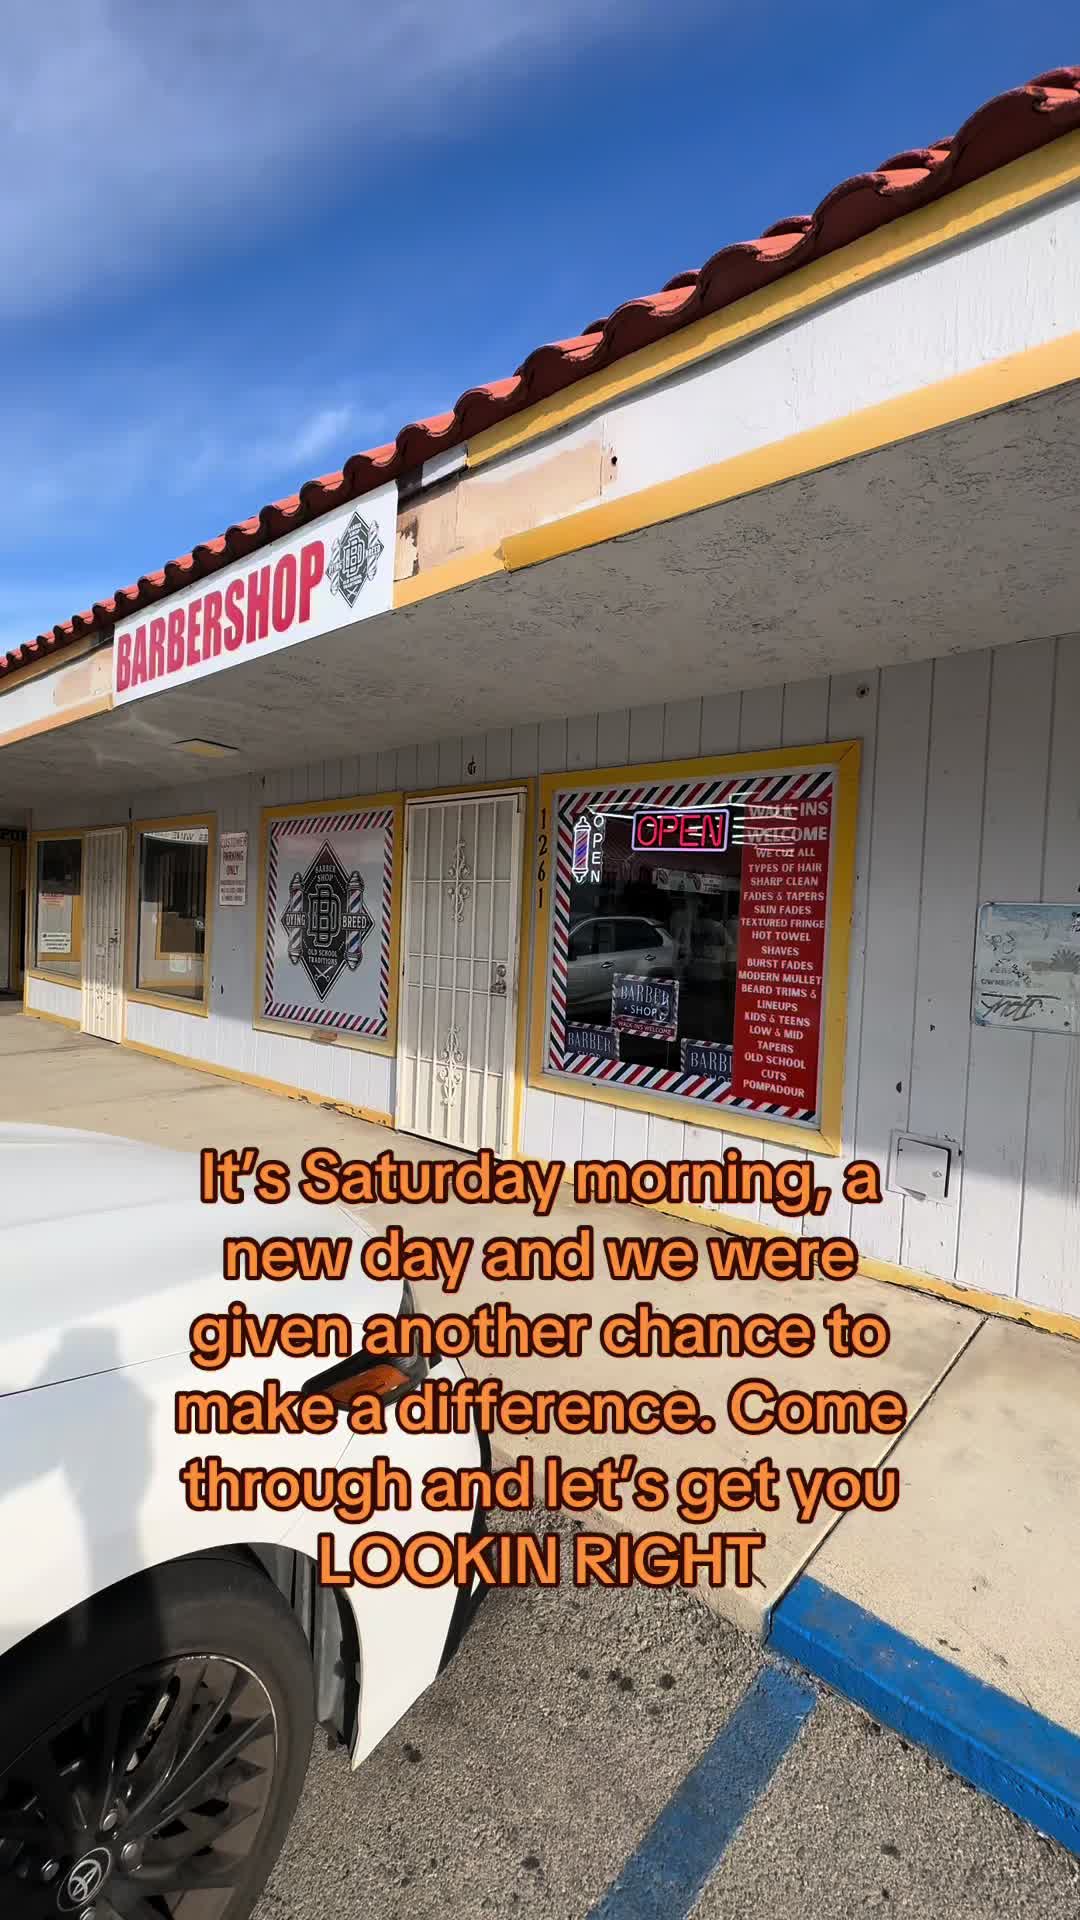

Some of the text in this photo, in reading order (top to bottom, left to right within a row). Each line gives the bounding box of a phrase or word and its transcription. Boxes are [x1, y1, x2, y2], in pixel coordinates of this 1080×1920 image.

[117, 540, 324, 692] BARBERSHOP
[801, 801, 828, 816] INS
[637, 815, 723, 847] OPEN
[748, 827, 827, 843] WELCOME
[590, 815, 604, 883] OPEN
[756, 850, 772, 858] WE
[798, 848, 815, 857] ALL
[537, 808, 548, 908] 1261
[749, 863, 822, 872] TYPES OF HAIR
[317, 873, 334, 882] SHOP
[751, 877, 818, 886] SHARP CLEAN
[743, 892, 777, 900] FADES
[787, 892, 824, 900] TAPERS
[754, 905, 811, 914] SKIN FADES
[285, 912, 306, 926] DYING
[342, 915, 367, 929] BREED
[741, 918, 825, 928] TEXTURED FRINGE
[752, 931, 811, 941] HOT TOWEL
[761, 946, 799, 955] SHAVES
[747, 958, 813, 970] BURST FADES
[738, 971, 822, 985] MODERN MULLET
[620, 984, 670, 1006] BARBER
[742, 984, 817, 999] BEARD TRIMS &
[630, 1004, 658, 1017] SHOP
[757, 1000, 798, 1012] LINEUPS
[745, 1012, 810, 1027] KIDS & TEENS
[750, 1026, 804, 1039] LOW & MID
[568, 1031, 612, 1052] BARBER
[758, 1040, 794, 1054] TAPERS
[690, 1051, 732, 1072] BARB
[744, 1052, 806, 1069] OLD SCHOOL
[761, 1069, 787, 1081] CUTS
[743, 1079, 805, 1098] POMPADOUR
